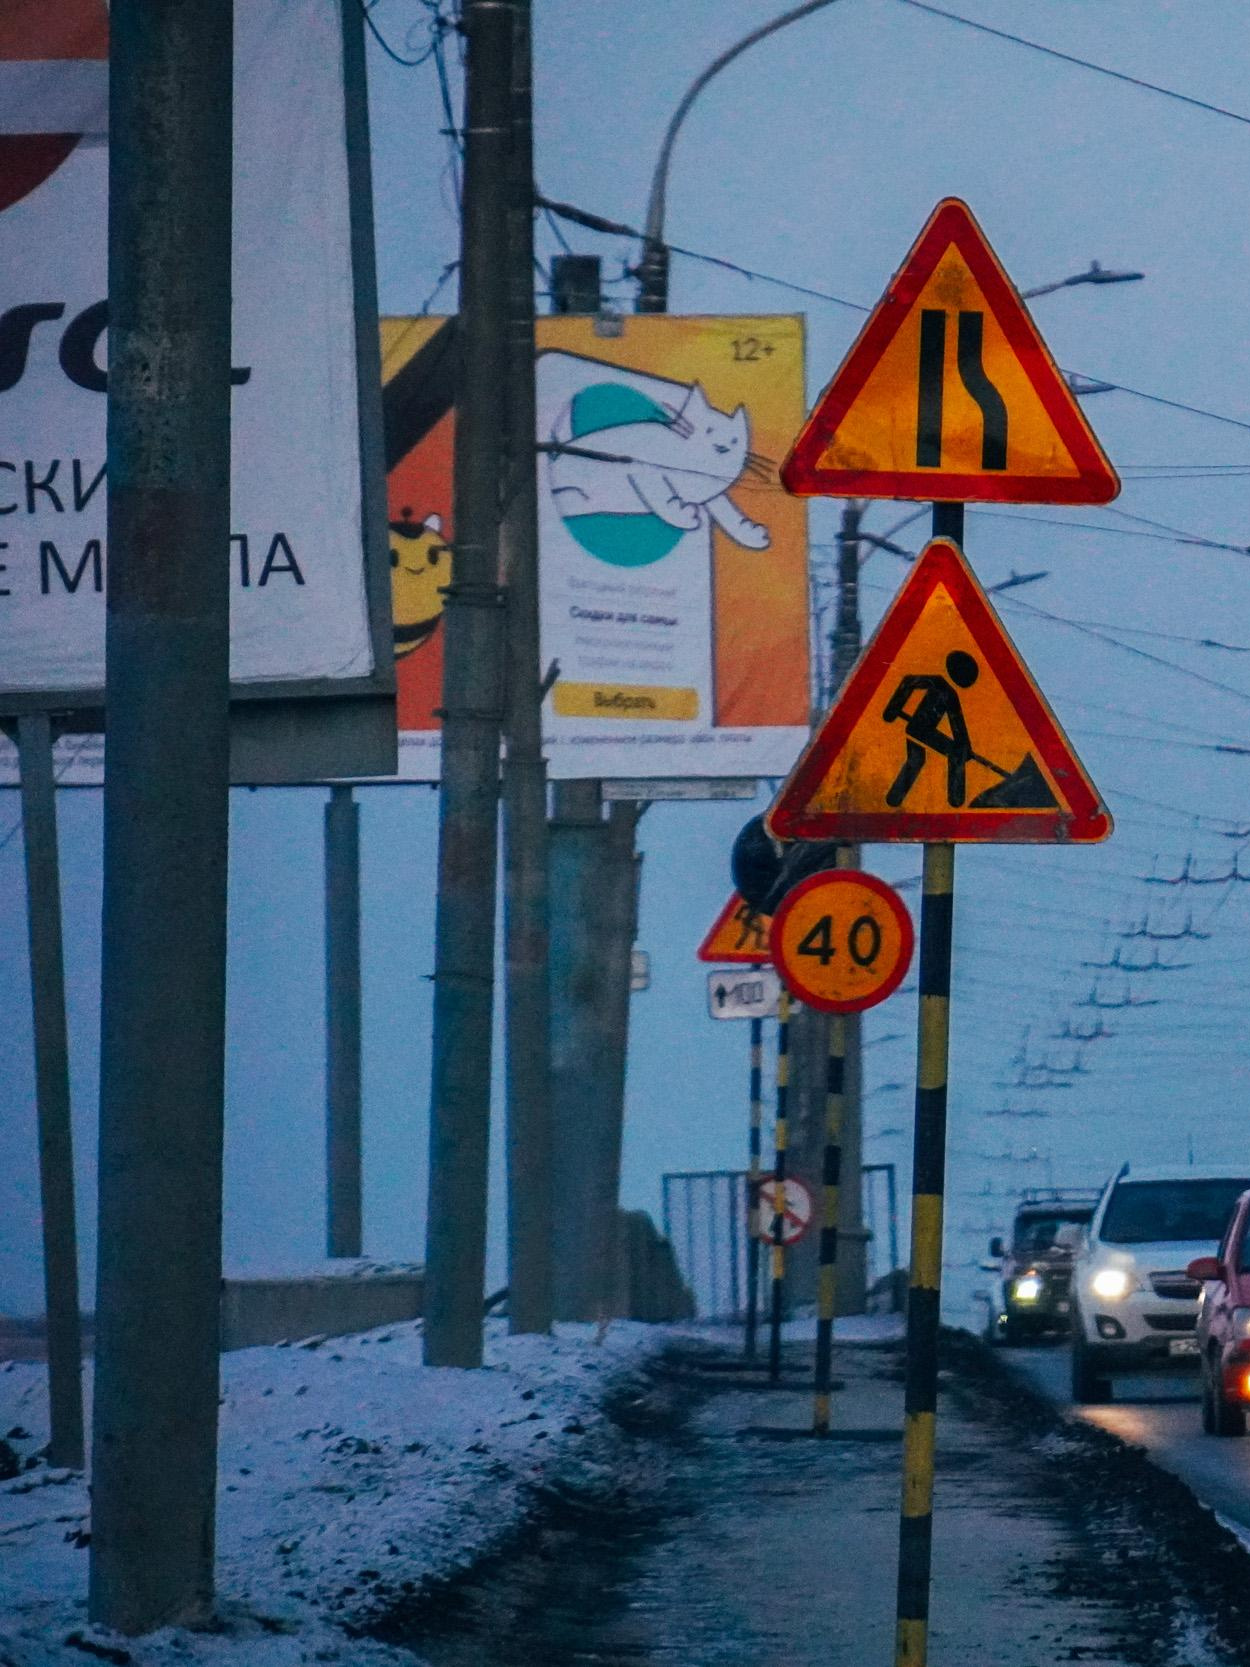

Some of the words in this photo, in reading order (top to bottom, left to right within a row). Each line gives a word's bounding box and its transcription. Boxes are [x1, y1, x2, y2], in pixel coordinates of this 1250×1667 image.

[730, 337, 777, 361] 12+
[39, 532, 305, 594] МЛА
[797, 914, 881, 967] 40
